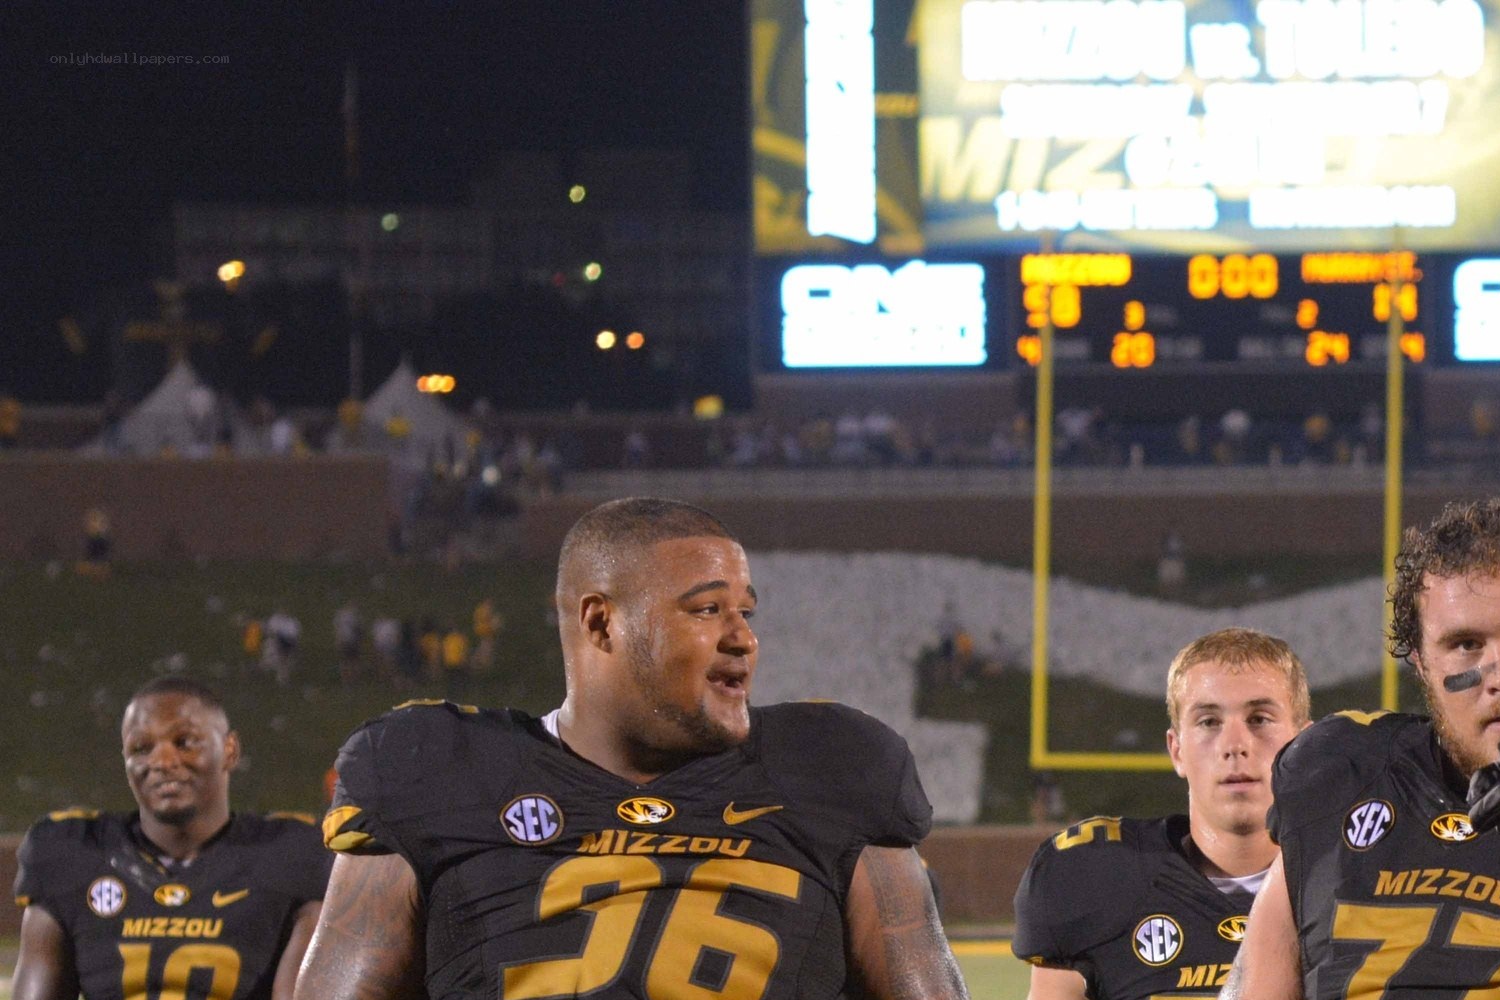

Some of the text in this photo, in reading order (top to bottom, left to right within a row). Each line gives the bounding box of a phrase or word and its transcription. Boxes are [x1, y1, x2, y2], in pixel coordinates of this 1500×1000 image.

[503, 796, 559, 842] SEC
[1346, 801, 1394, 848] SEC
[576, 830, 753, 858] MIZZOU
[90, 879, 124, 914] SEC
[122, 918, 223, 938] MIZZOU
[1135, 917, 1180, 963] SEC
[1176, 964, 1234, 988] MIZ
